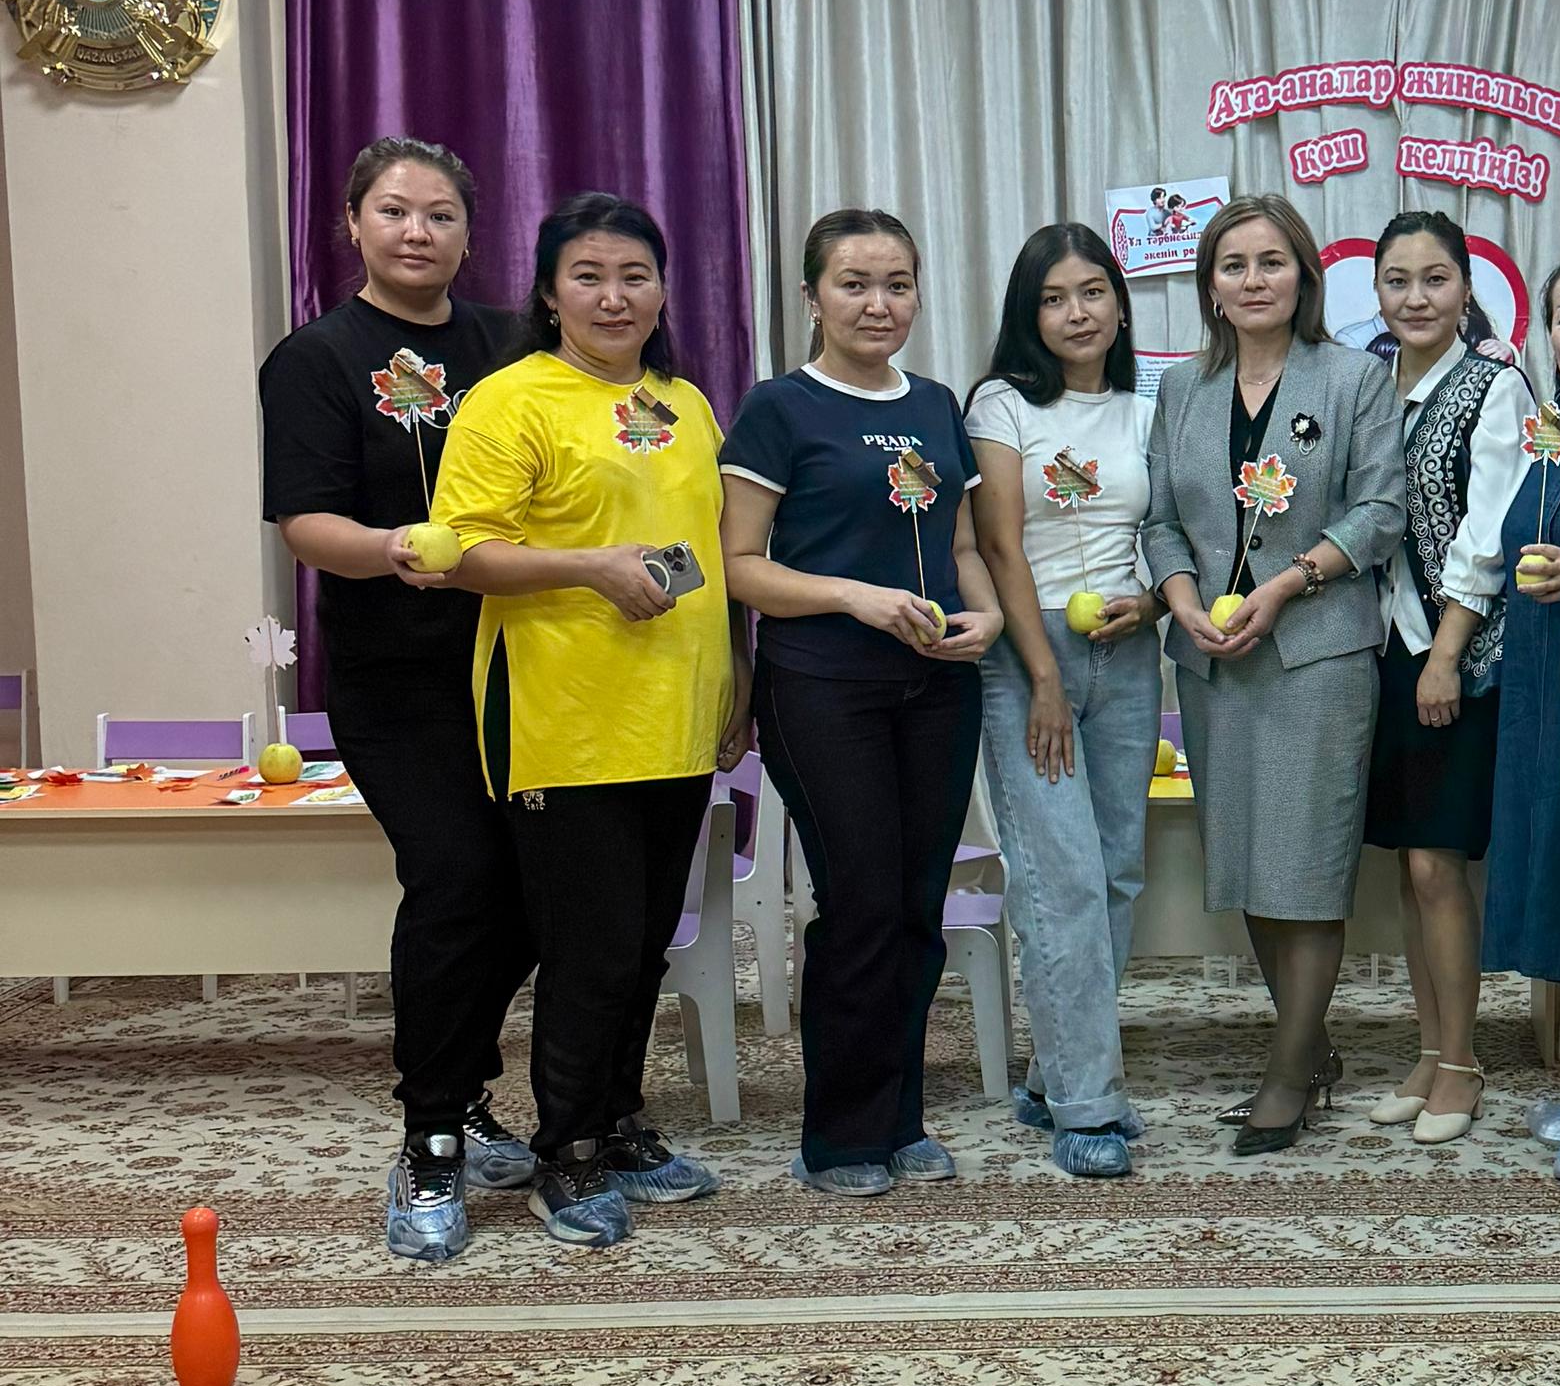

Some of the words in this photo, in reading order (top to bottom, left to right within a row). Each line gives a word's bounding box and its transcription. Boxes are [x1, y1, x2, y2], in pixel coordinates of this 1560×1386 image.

[1212, 67, 1393, 125] Ата-аналар
[1403, 143, 1543, 195] келдіңіз!
[862, 434, 923, 447] PRADA
